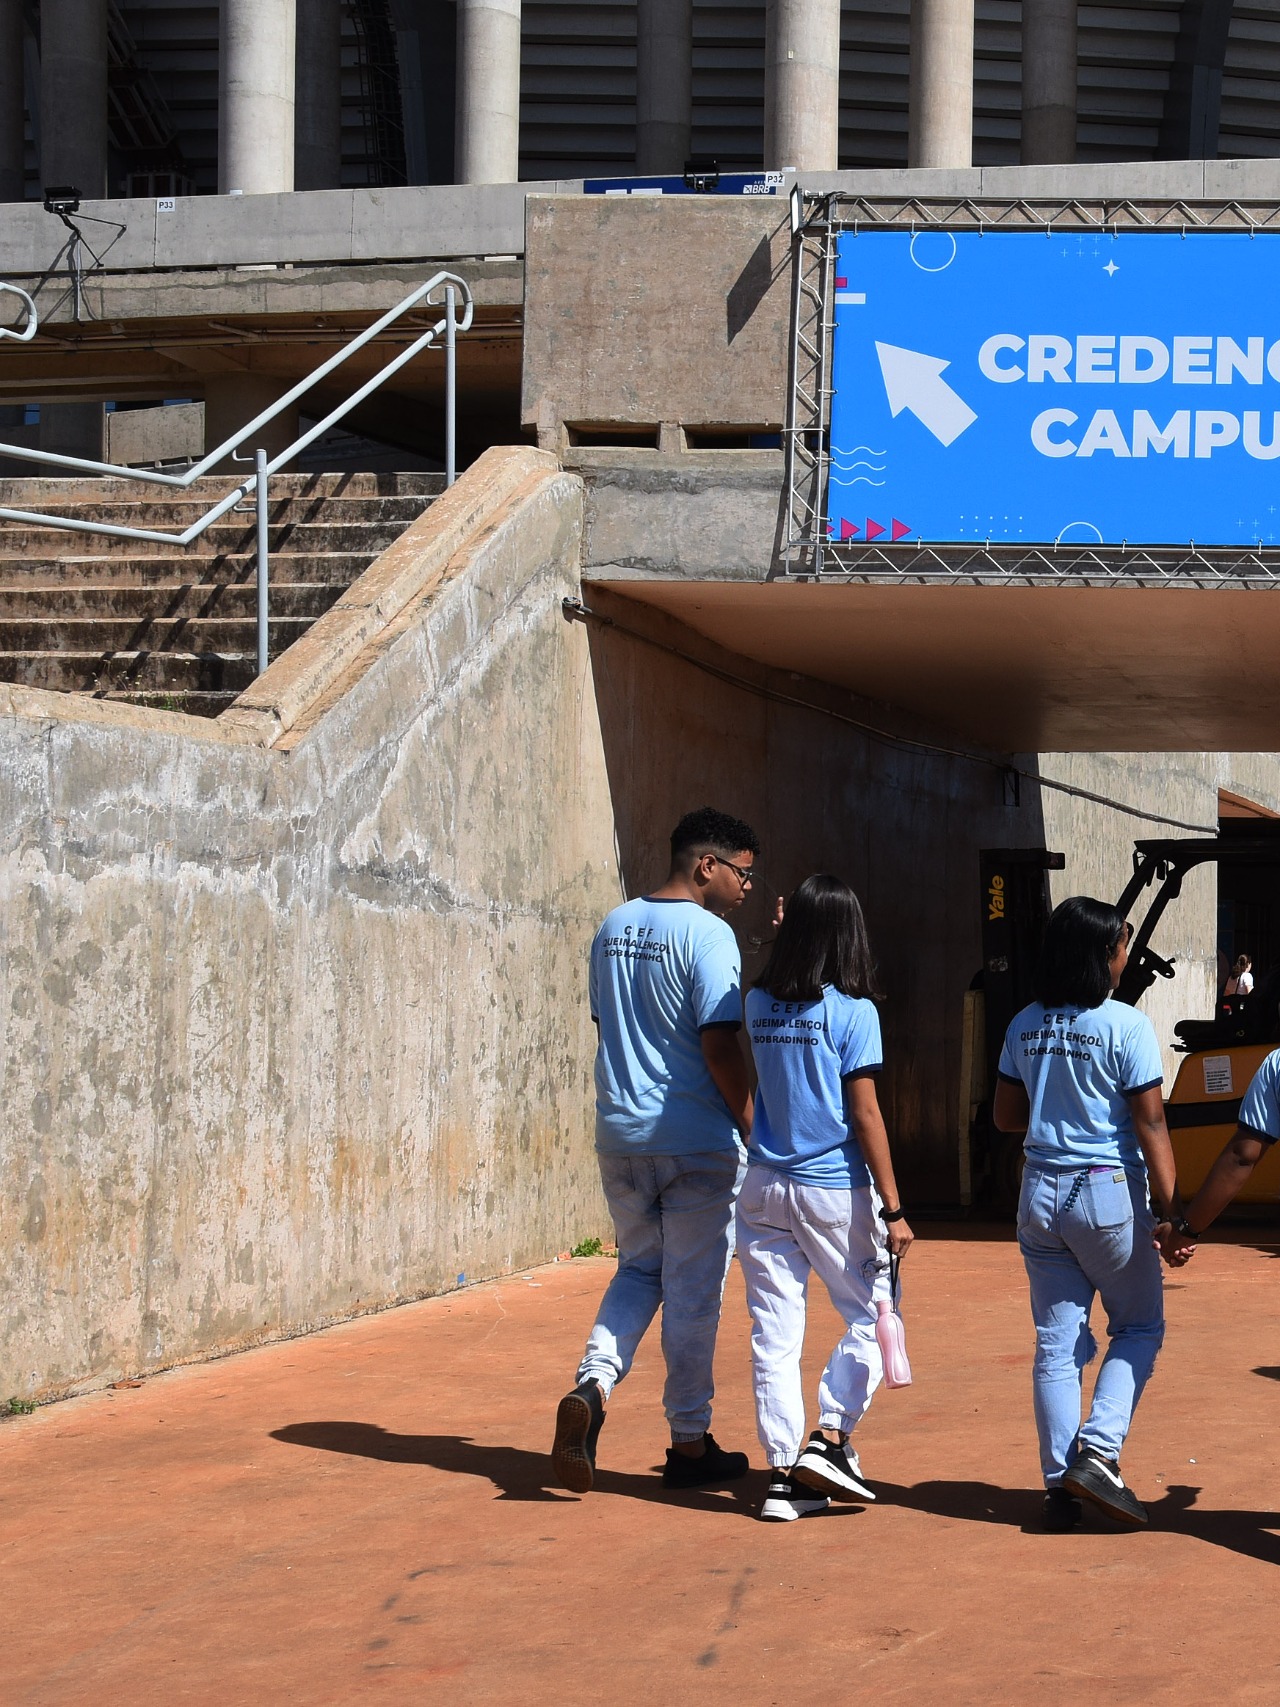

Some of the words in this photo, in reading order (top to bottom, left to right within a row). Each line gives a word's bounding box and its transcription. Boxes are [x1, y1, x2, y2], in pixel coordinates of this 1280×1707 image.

[767, 175, 783, 183] P32
[752, 184, 770, 194] BRB
[158, 201, 173, 209] P33
[988, 875, 1005, 920] Yale
[788, 1019, 829, 1032] LENÇOL
[753, 1035, 819, 1046] SOBRADINHO
[1020, 1029, 1057, 1042] QUEIMA
[1059, 1029, 1103, 1047] LENÇOL
[1023, 1047, 1091, 1061] SOBRADINHO
